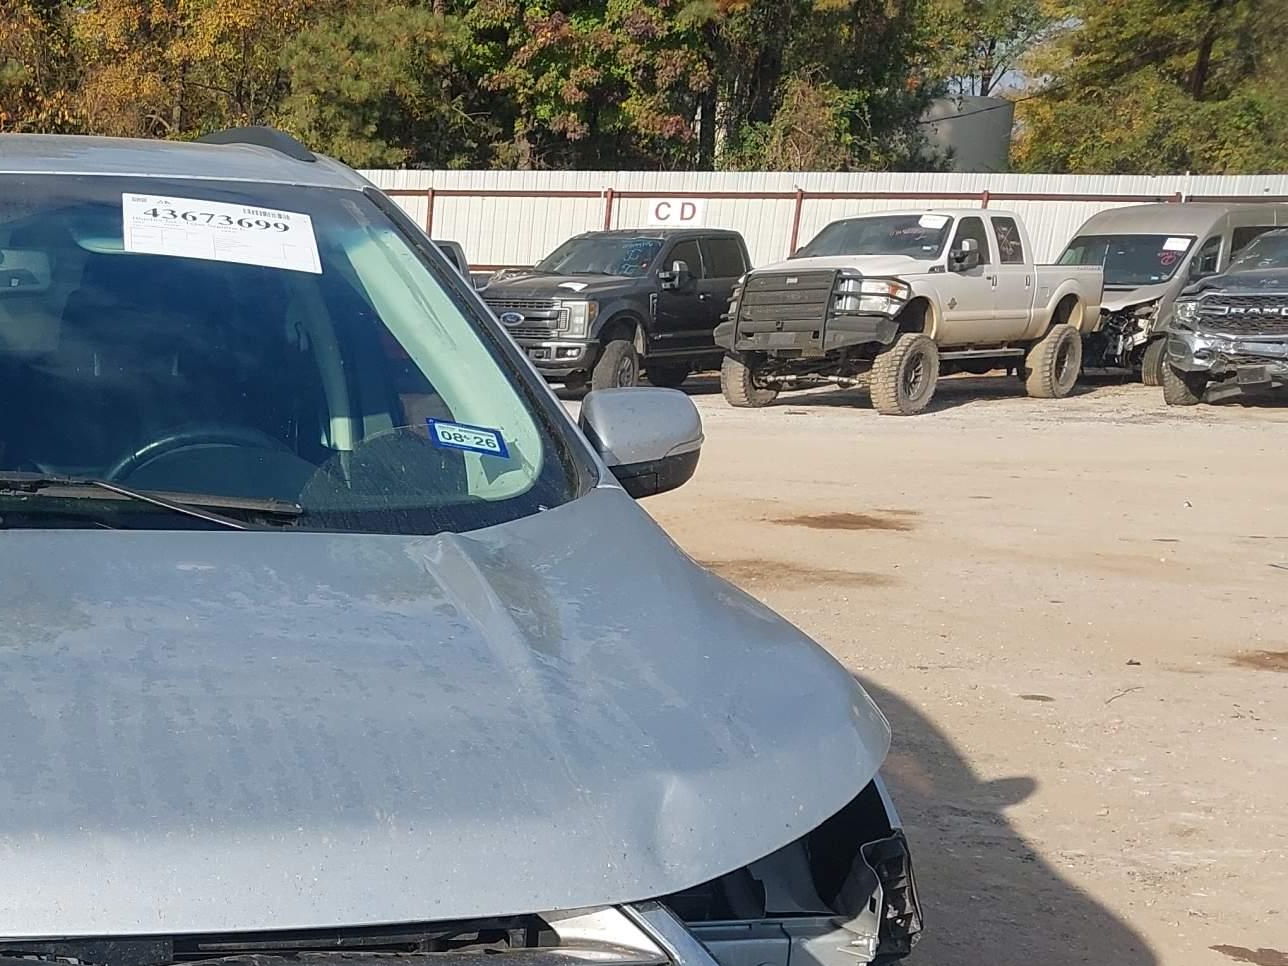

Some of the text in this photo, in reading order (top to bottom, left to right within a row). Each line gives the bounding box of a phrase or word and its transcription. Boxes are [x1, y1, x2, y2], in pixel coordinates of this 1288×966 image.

[143, 207, 290, 233] 43673699
[655, 201, 696, 221] C D
[1230, 307, 1279, 315] RAM
[441, 430, 465, 443] 08
[473, 436, 497, 449] 26
